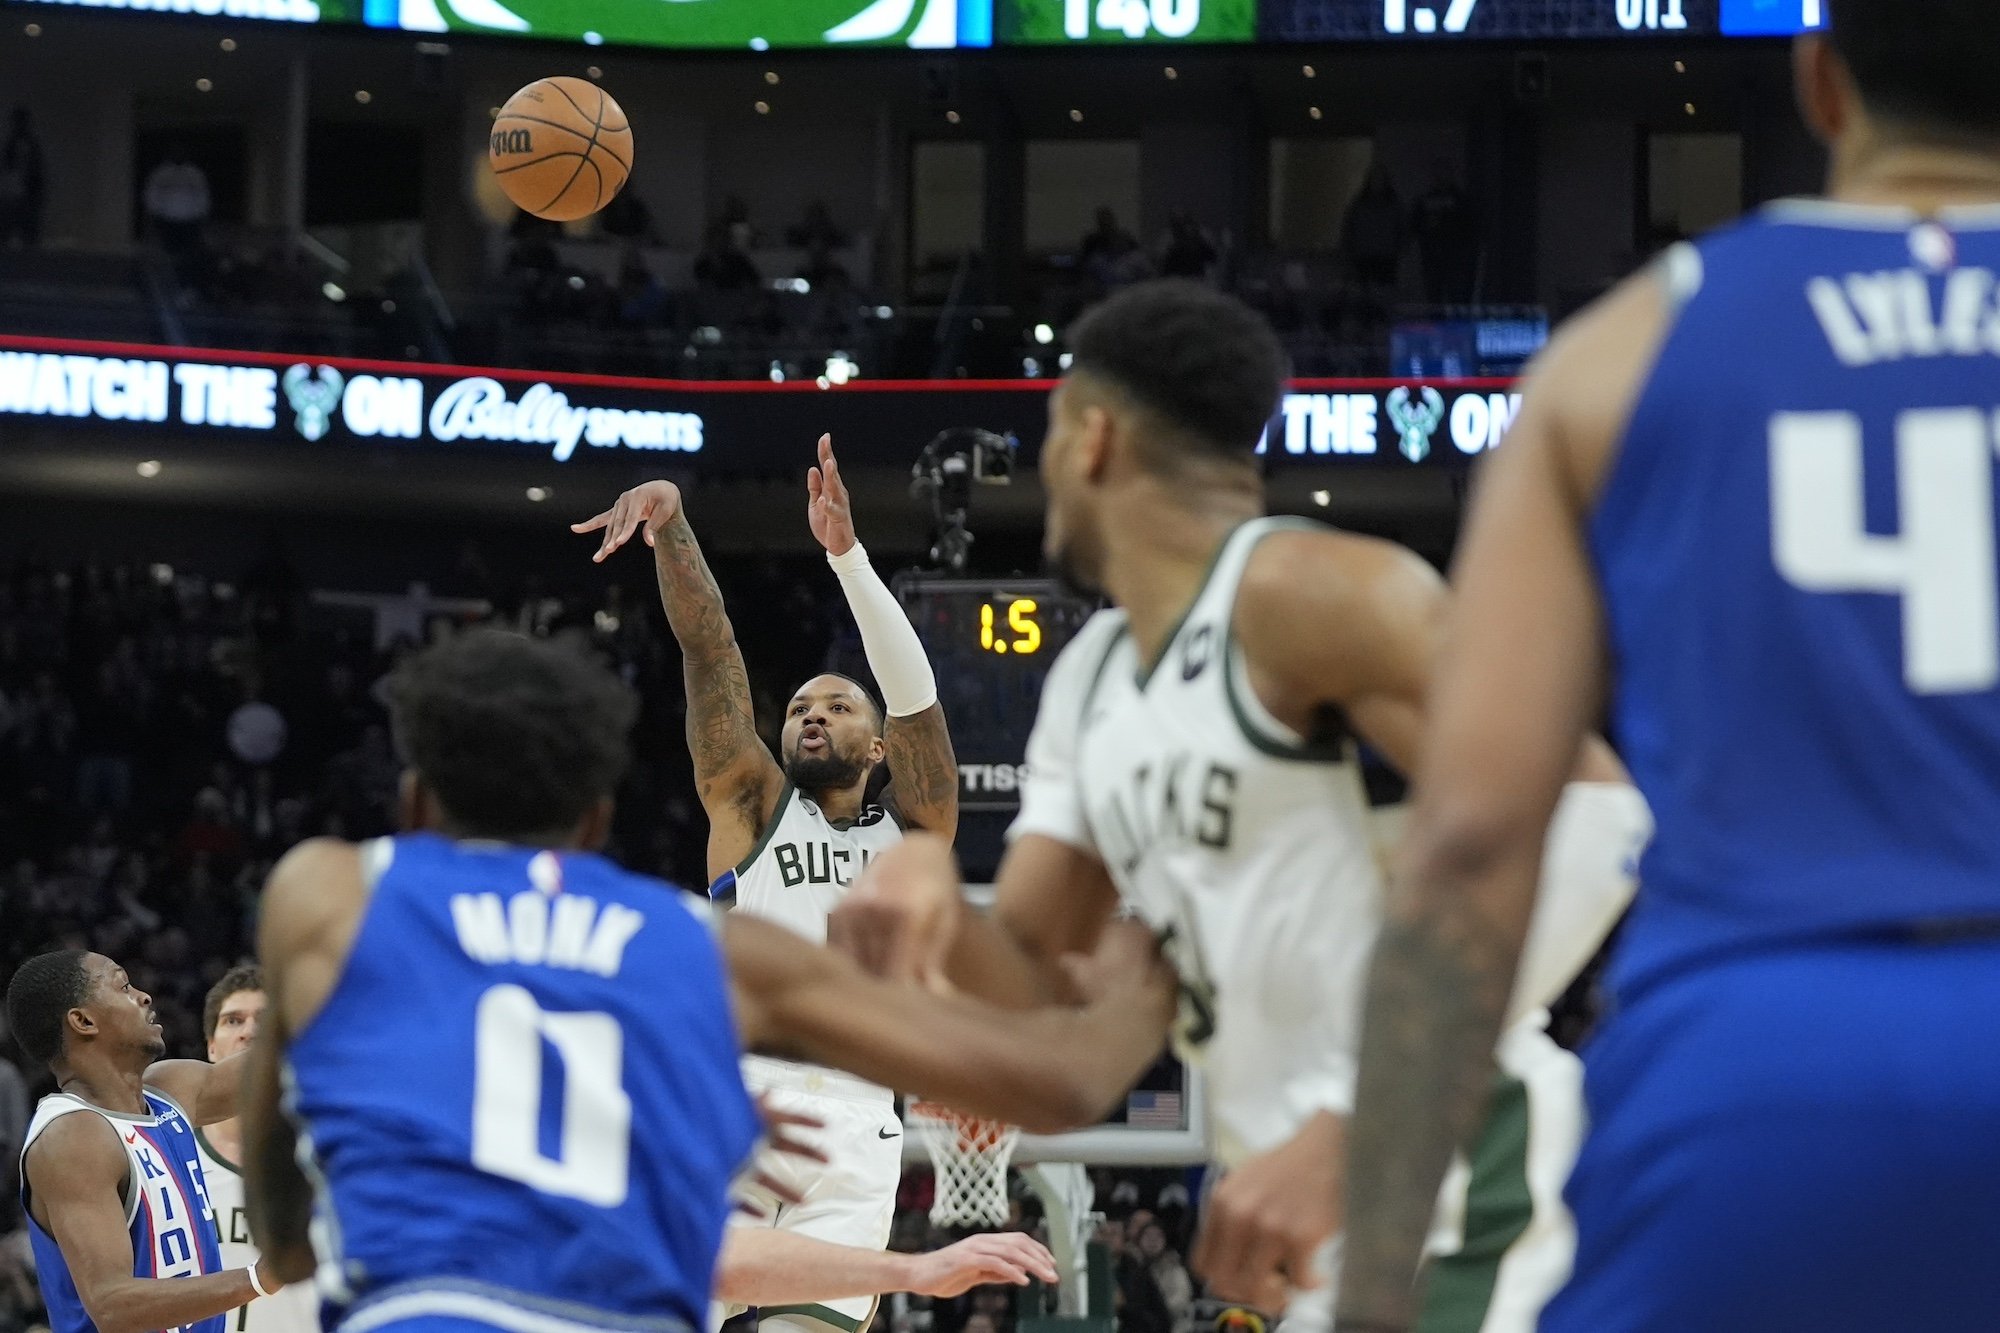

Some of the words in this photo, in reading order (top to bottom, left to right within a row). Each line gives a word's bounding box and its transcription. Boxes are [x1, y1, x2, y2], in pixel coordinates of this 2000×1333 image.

[0, 351, 169, 422] WATCH
[173, 363, 277, 429] THE
[342, 375, 424, 438] ON
[429, 376, 589, 461] Bally
[585, 407, 703, 452] SPORTS
[1282, 393, 1378, 454] THE
[1766, 405, 2000, 697] 4
[981, 599, 1041, 654] 1.5
[774, 841, 876, 888] BUC
[449, 889, 645, 979] MONK
[470, 982, 633, 1209] 0
[186, 1159, 213, 1221] 5
